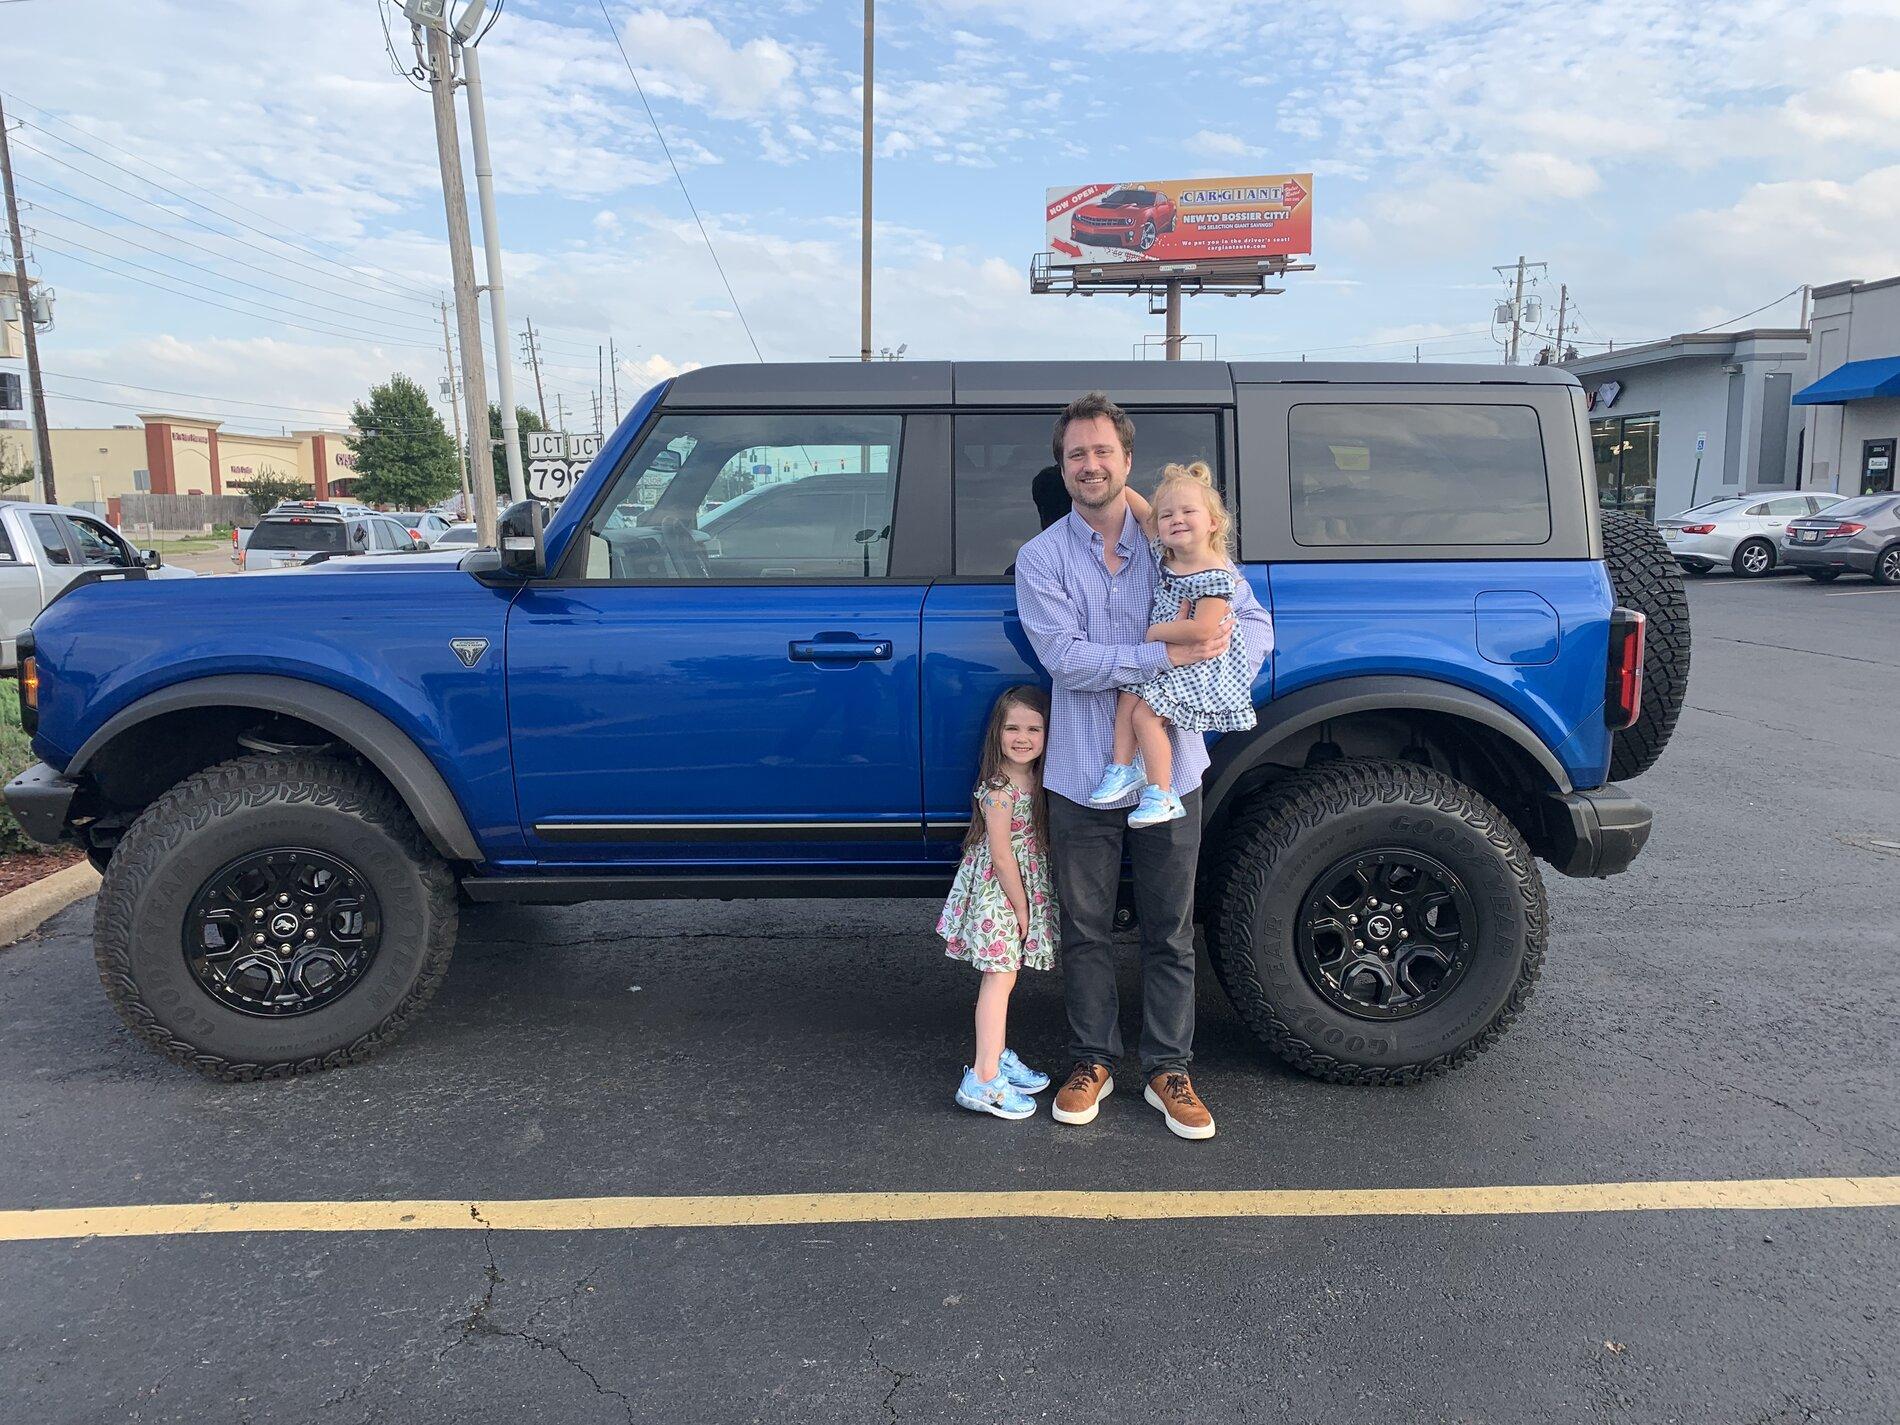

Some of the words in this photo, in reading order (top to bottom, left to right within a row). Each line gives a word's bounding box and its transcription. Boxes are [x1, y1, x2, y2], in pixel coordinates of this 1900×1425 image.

[1049, 200, 1069, 216] NOW
[1071, 185, 1098, 203] OPEN!
[1183, 214, 1206, 223] NEW
[1206, 213, 1220, 222] TO
[1221, 212, 1262, 221] BOSSIER
[1263, 211, 1289, 220] CITY!
[532, 436, 562, 454] JCT
[572, 437, 602, 455] JCT
[533, 468, 566, 490] 79
